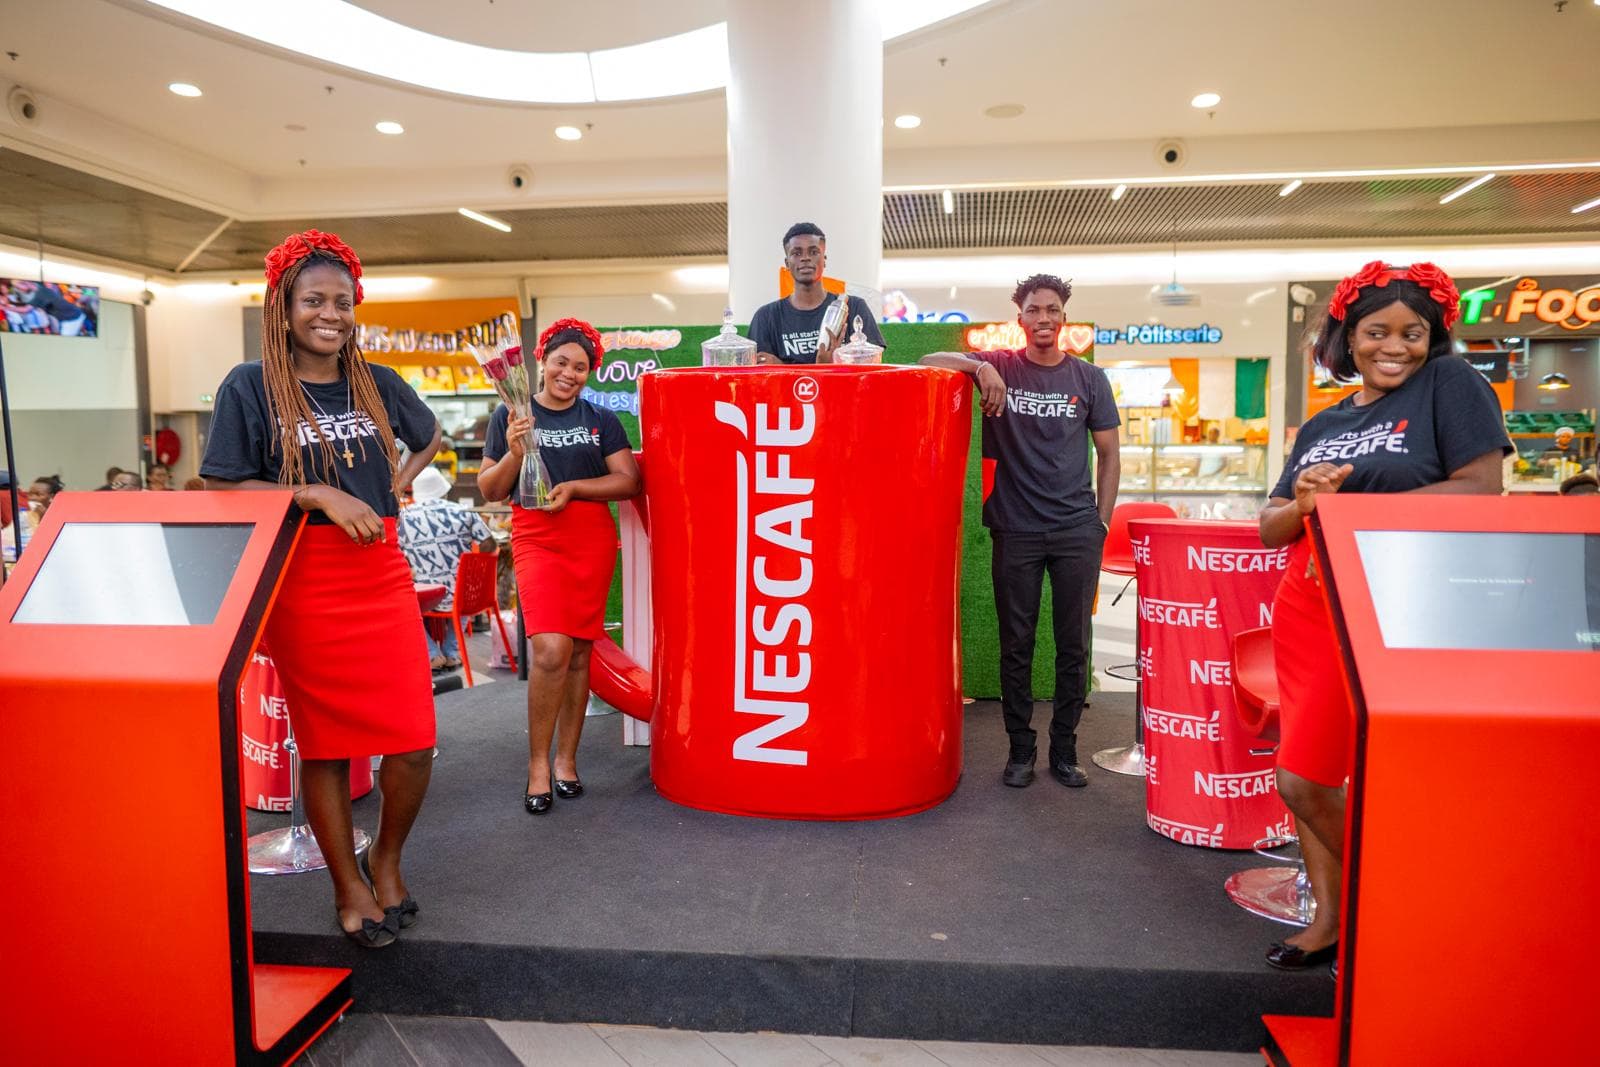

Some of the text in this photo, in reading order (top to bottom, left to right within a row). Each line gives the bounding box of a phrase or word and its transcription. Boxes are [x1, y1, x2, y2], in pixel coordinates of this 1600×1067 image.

[1024, 391, 1045, 400] starts
[1045, 392, 1063, 400] with
[538, 427, 600, 448] ESCAFÉ
